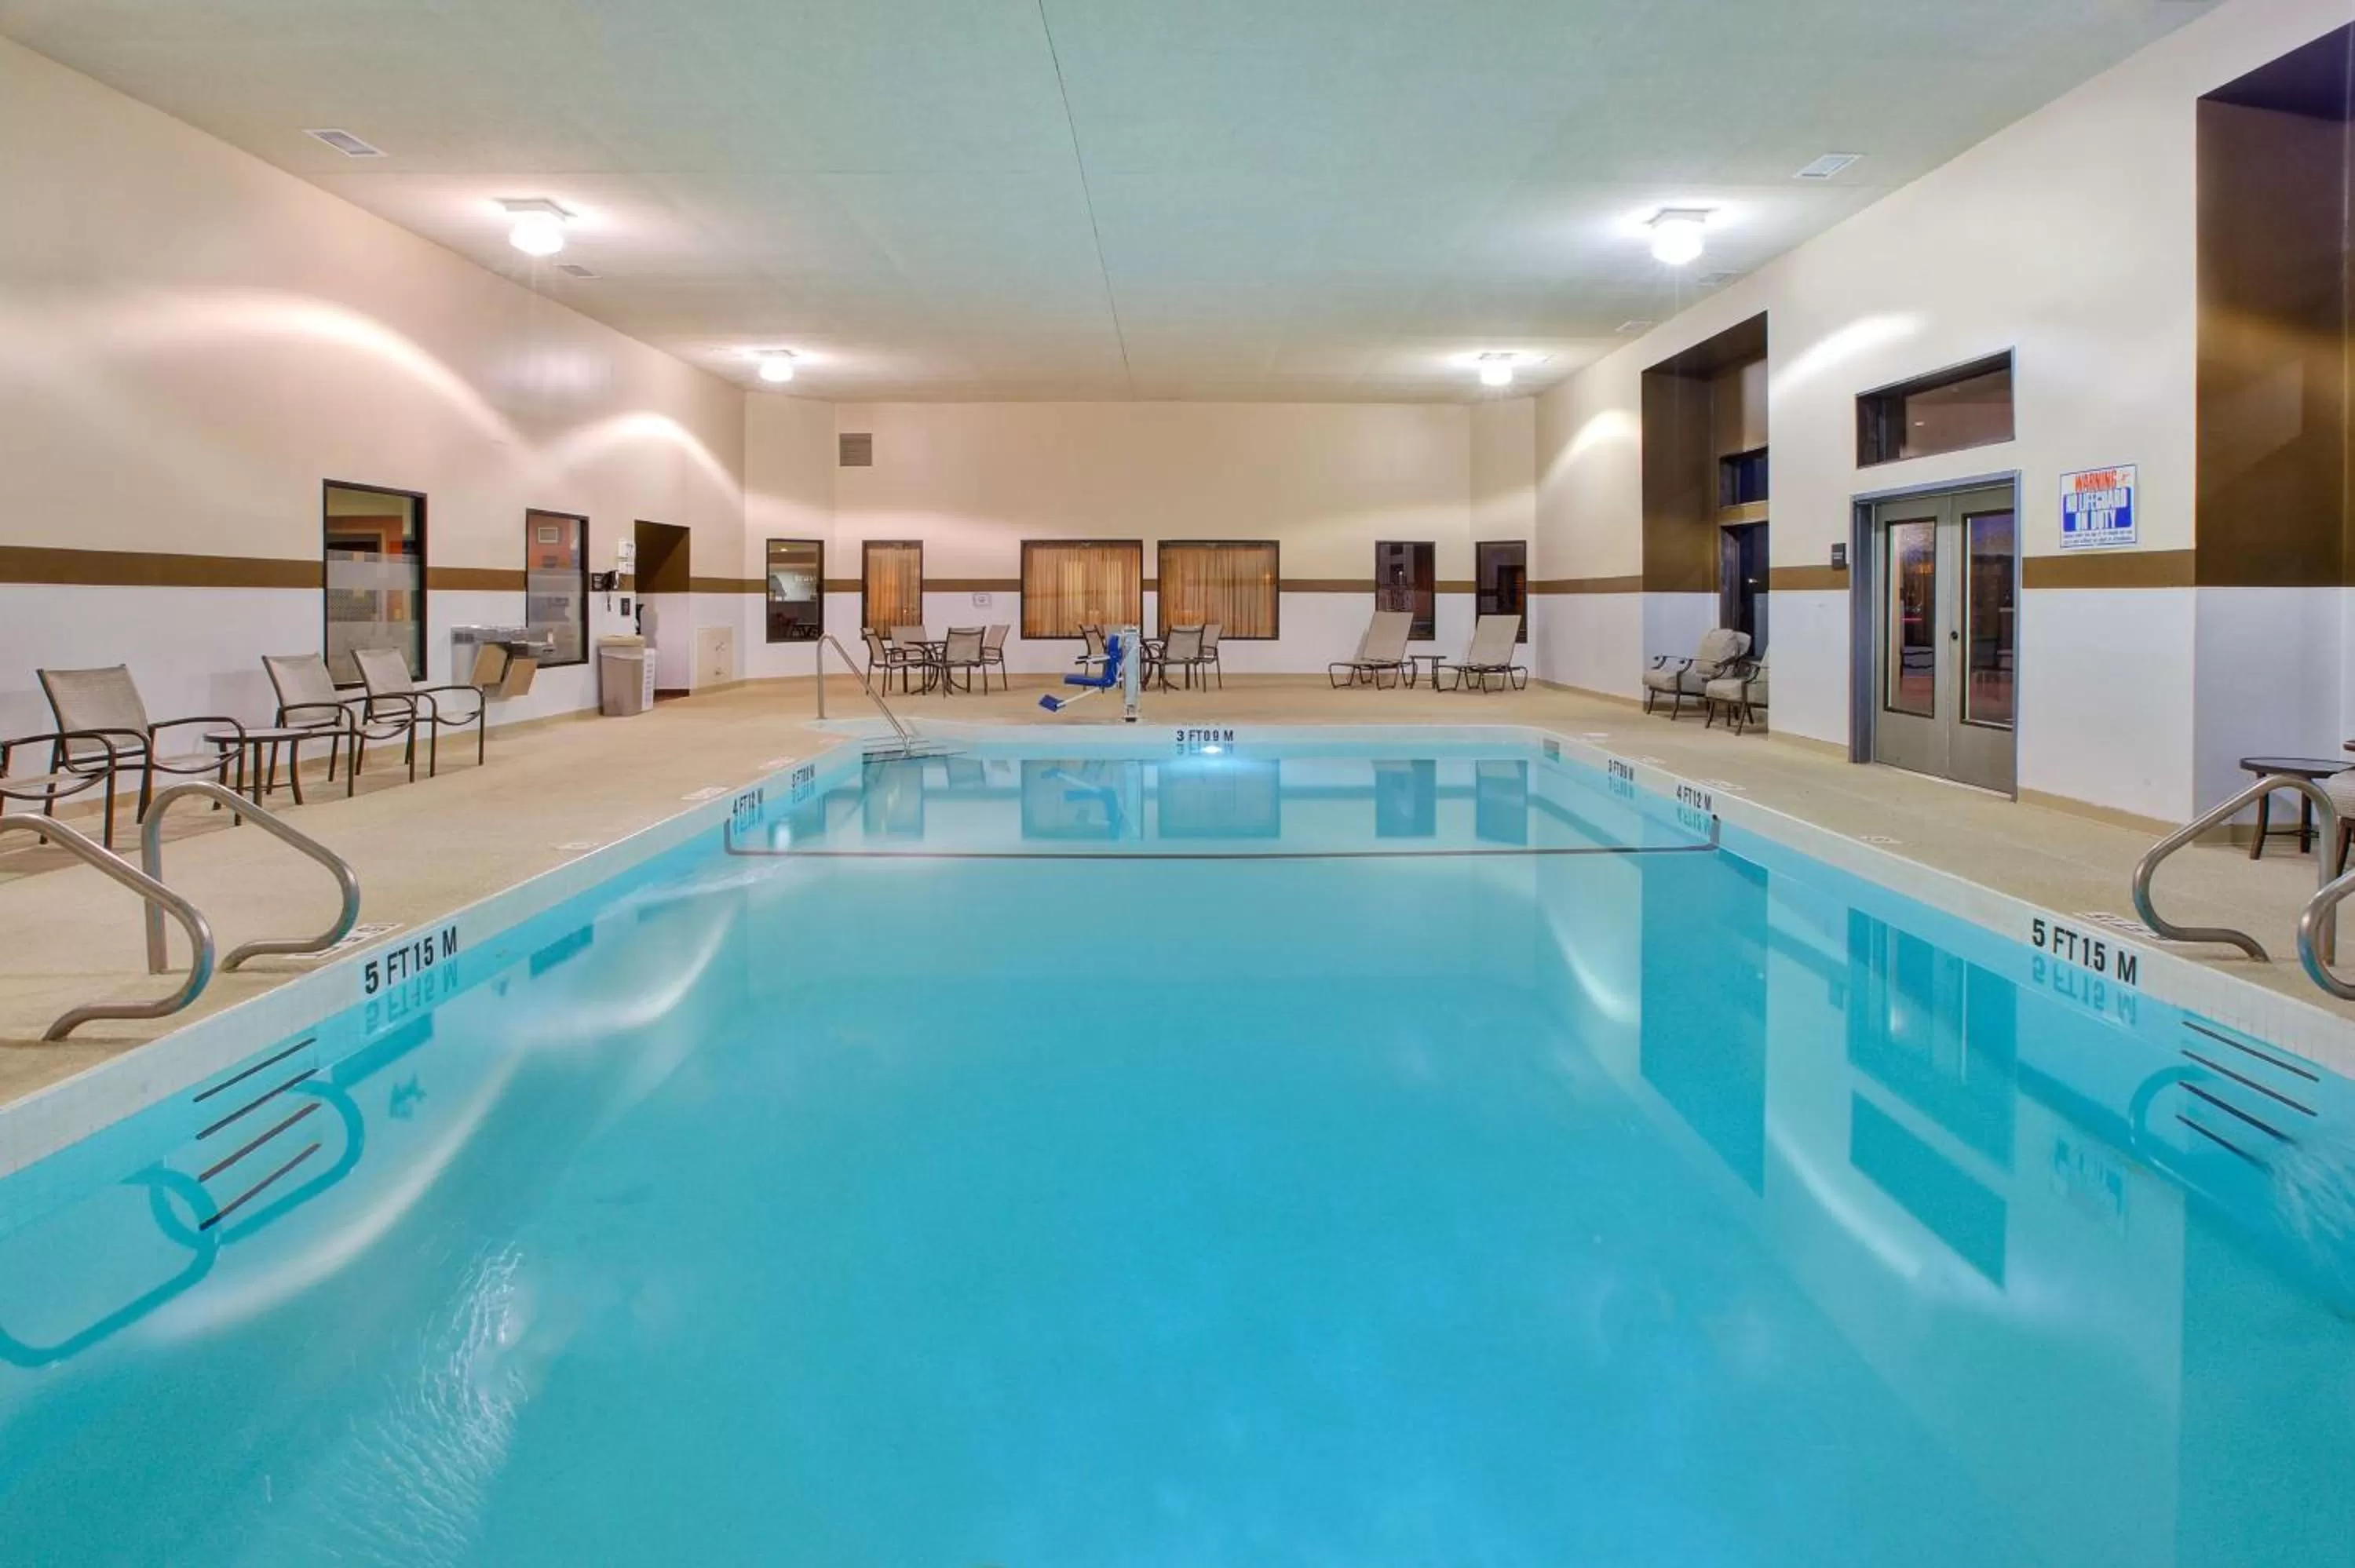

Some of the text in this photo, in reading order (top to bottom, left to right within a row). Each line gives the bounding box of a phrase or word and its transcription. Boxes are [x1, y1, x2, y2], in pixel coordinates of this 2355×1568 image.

[2074, 469, 2117, 493] WARNING
[1177, 729, 1185, 742] 3
[1224, 729, 1233, 742] M
[365, 960, 378, 994] 5
[442, 925, 457, 958] M
[2032, 917, 2045, 947] 5
[2117, 950, 2137, 986] M
